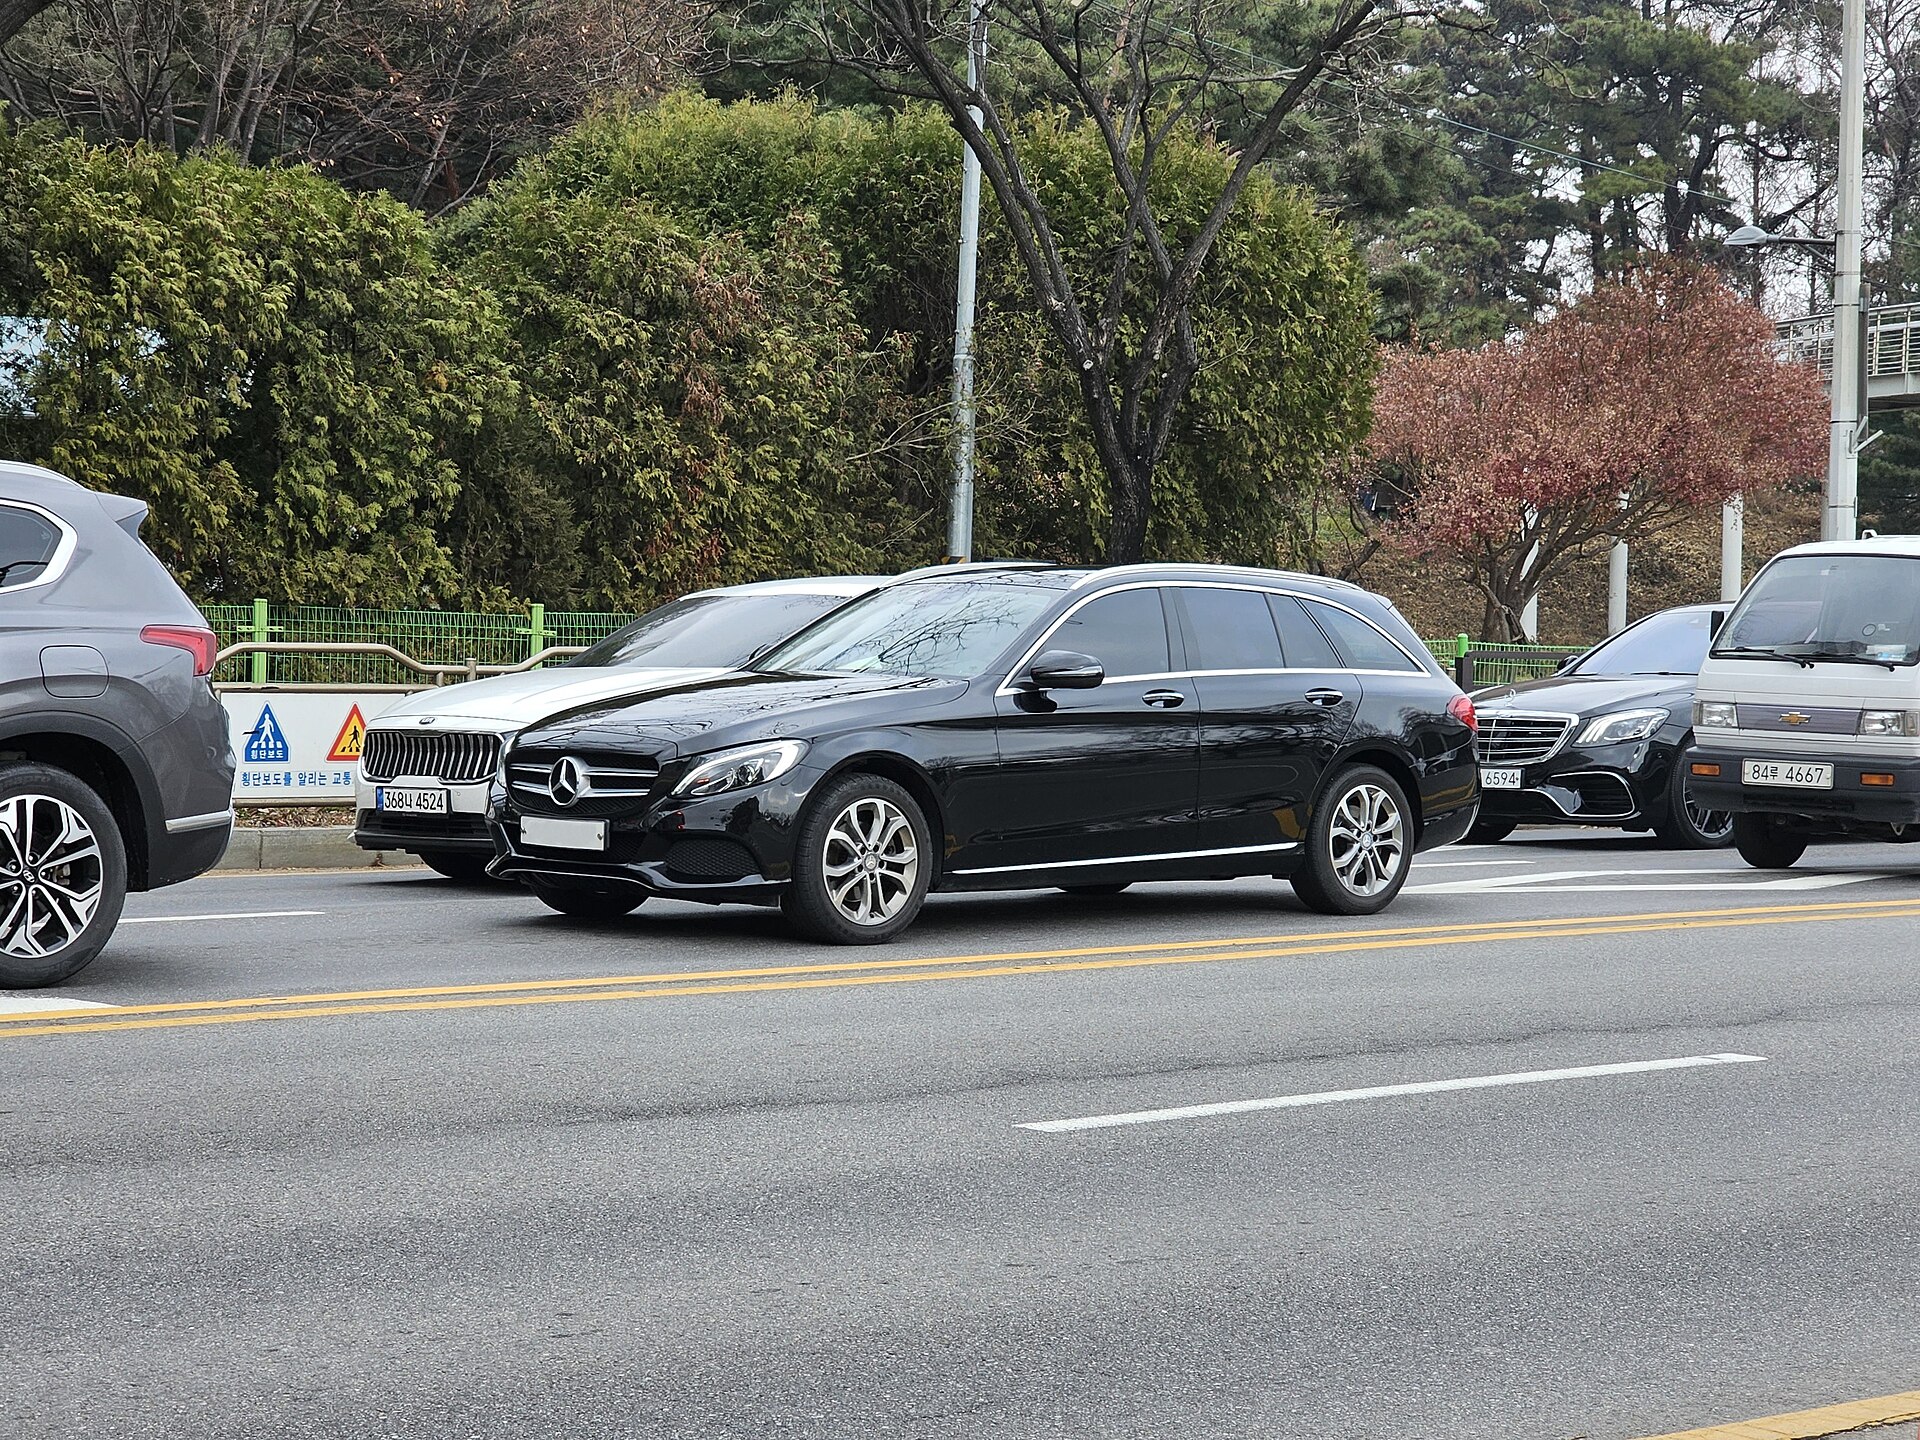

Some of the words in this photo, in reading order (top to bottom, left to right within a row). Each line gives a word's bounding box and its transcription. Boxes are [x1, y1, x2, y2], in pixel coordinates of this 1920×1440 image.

[251, 750, 284, 760] 횡단보도
[242, 772, 292, 787] 횡단보도를
[298, 772, 327, 787] 알리는
[332, 772, 351, 786] 교통
[1485, 772, 1516, 786] 6594
[1785, 766, 1824, 783] 4667
[384, 791, 413, 809] 368나
[416, 793, 444, 810] 4524
